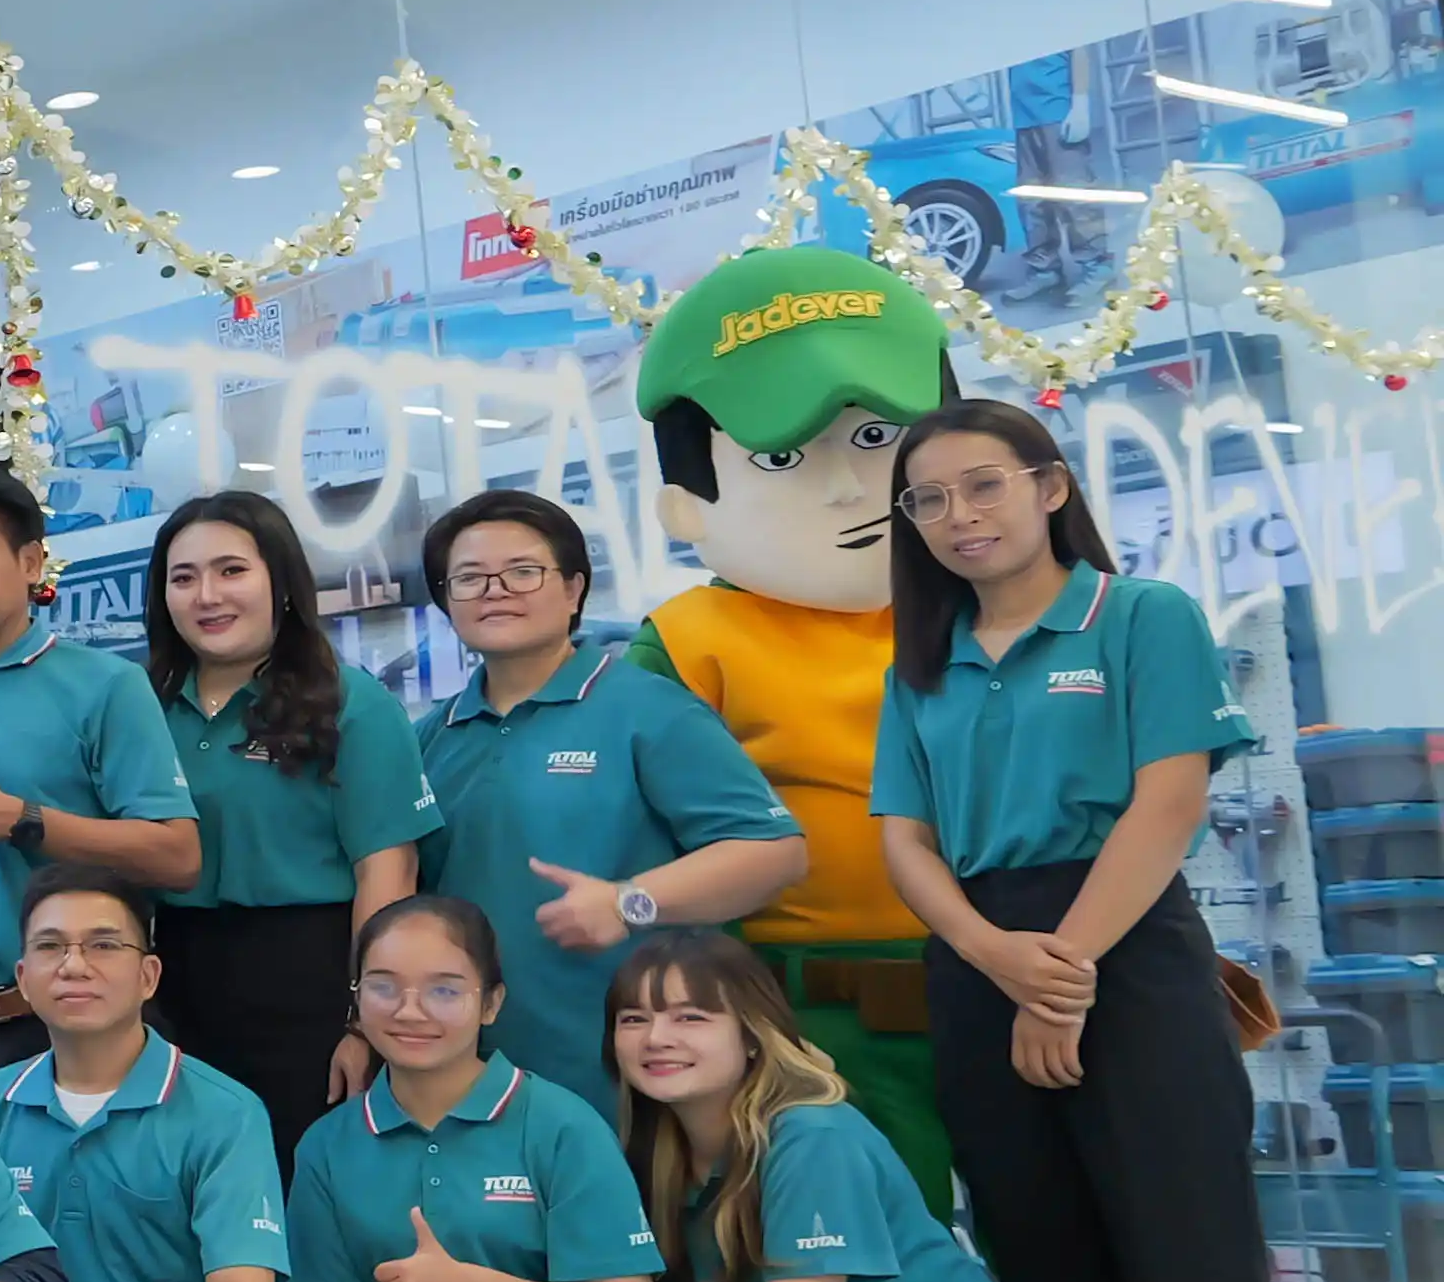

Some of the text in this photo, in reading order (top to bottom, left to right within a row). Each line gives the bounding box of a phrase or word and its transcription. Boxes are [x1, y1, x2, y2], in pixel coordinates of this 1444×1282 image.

[469, 230, 519, 261] โทท
[712, 290, 885, 359] Jadever
[1048, 668, 1106, 686] TOTAL
[547, 751, 597, 765] TOTAL
[796, 1235, 847, 1249] TOTAL
